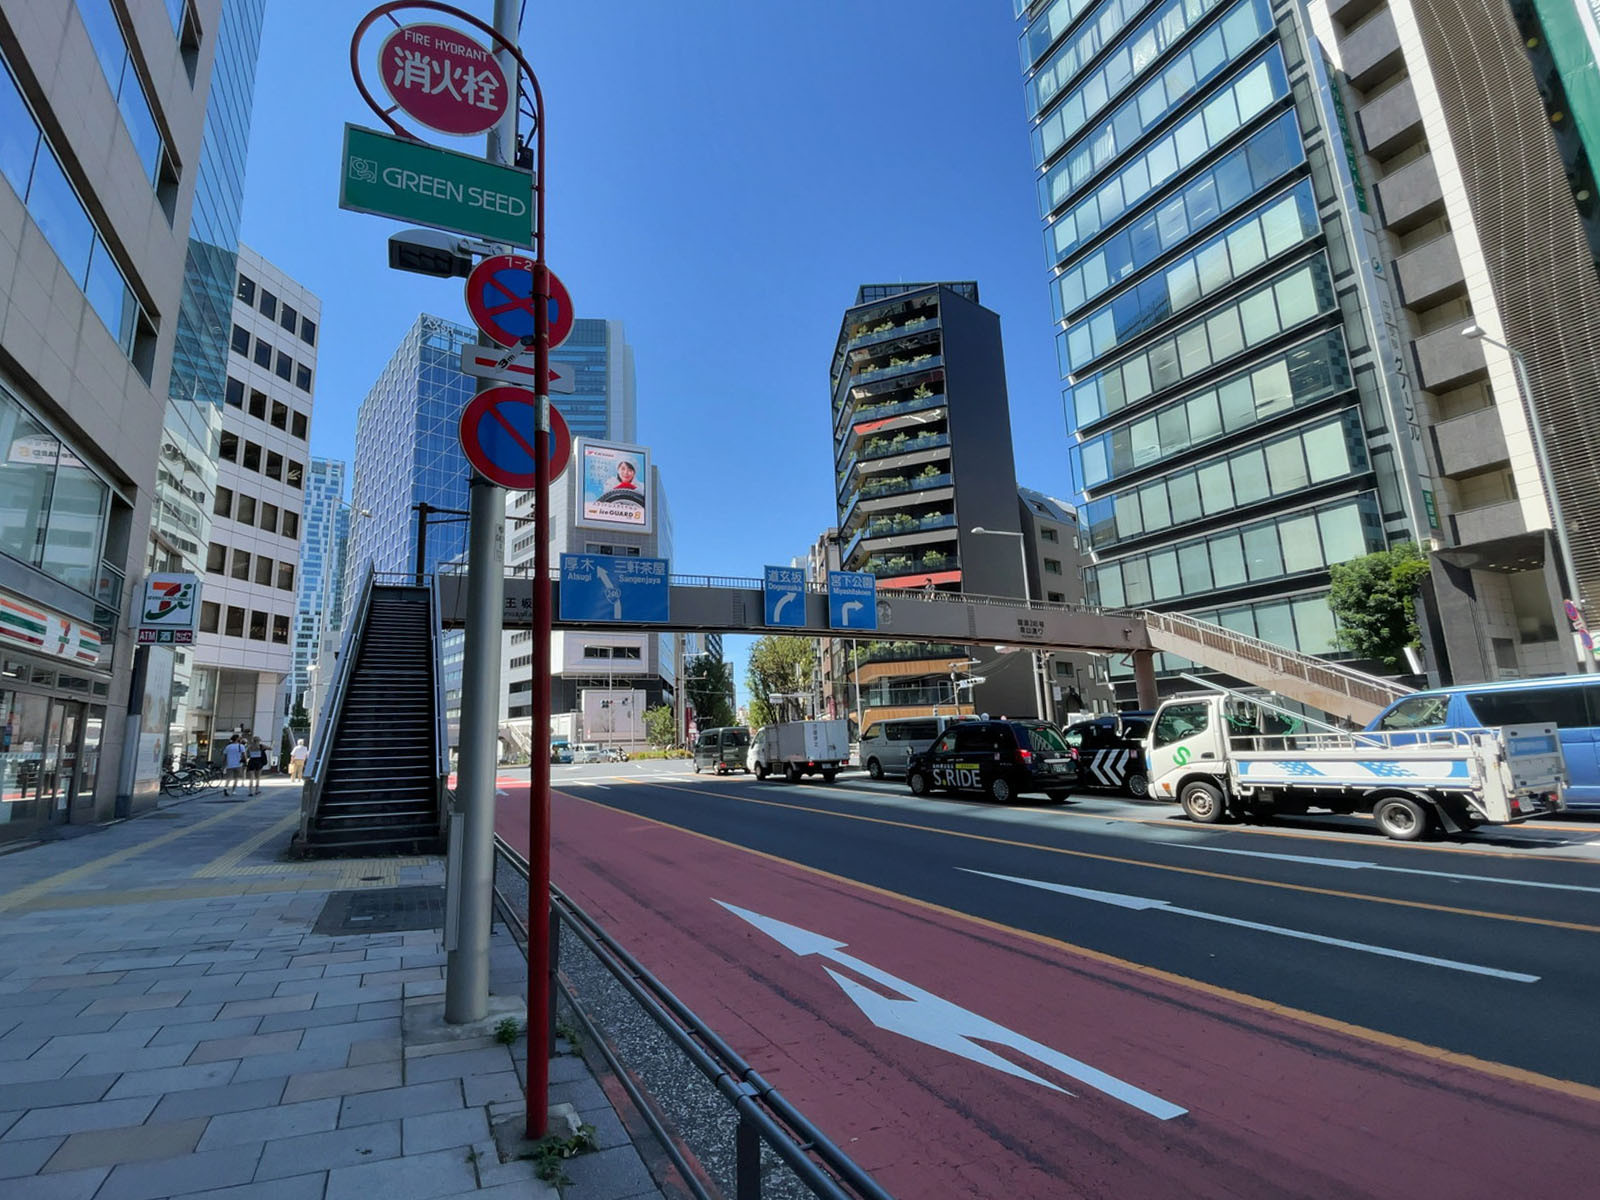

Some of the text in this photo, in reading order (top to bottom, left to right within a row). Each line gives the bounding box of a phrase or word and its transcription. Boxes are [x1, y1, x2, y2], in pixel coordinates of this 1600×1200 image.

[405, 30, 488, 63] FIRE HYDRANT
[393, 46, 499, 112] 消火栓
[382, 166, 526, 217] GREEN SEED
[564, 557, 666, 576] 厚木 三軒茶屋
[567, 573, 662, 585] Atsugi Sangenjaya
[768, 570, 802, 584] 道玄坂
[831, 575, 873, 589] 宮下公園
[139, 630, 156, 641] ATM
[932, 769, 983, 788] S.RIDE
